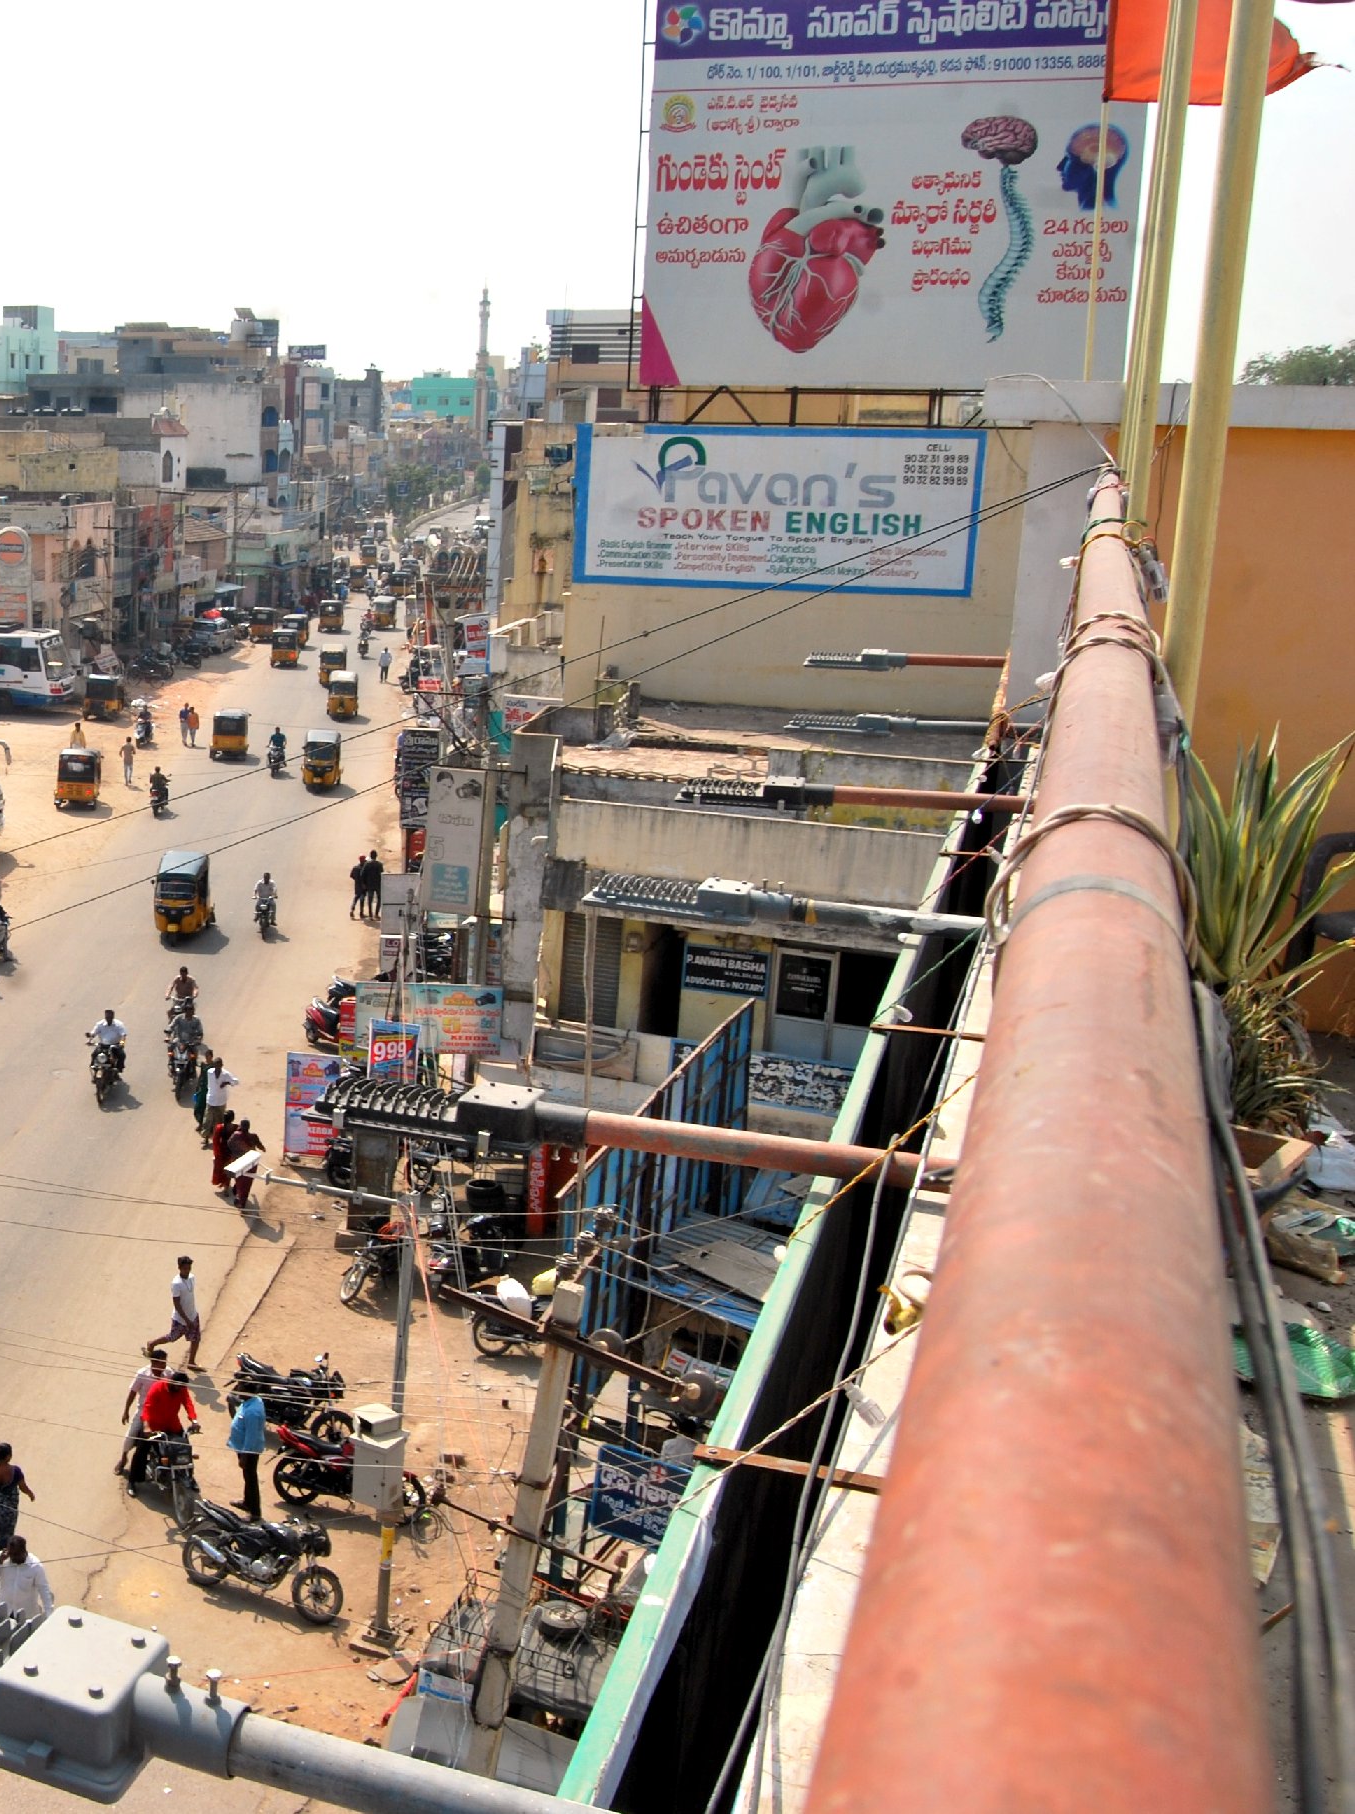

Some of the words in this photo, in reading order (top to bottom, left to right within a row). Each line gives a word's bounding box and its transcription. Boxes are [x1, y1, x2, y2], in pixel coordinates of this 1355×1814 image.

[993, 57, 1031, 71] 91000
[656, 212, 749, 236] ఉచితంగా
[1043, 219, 1069, 235] 24
[637, 507, 770, 532] SPOKEN
[785, 511, 922, 537] ENGLISH
[728, 960, 765, 973] BASHA
[685, 976, 725, 988] ADVOCATE
[732, 981, 765, 992] NOTARY
[373, 1042, 407, 1062] 999
